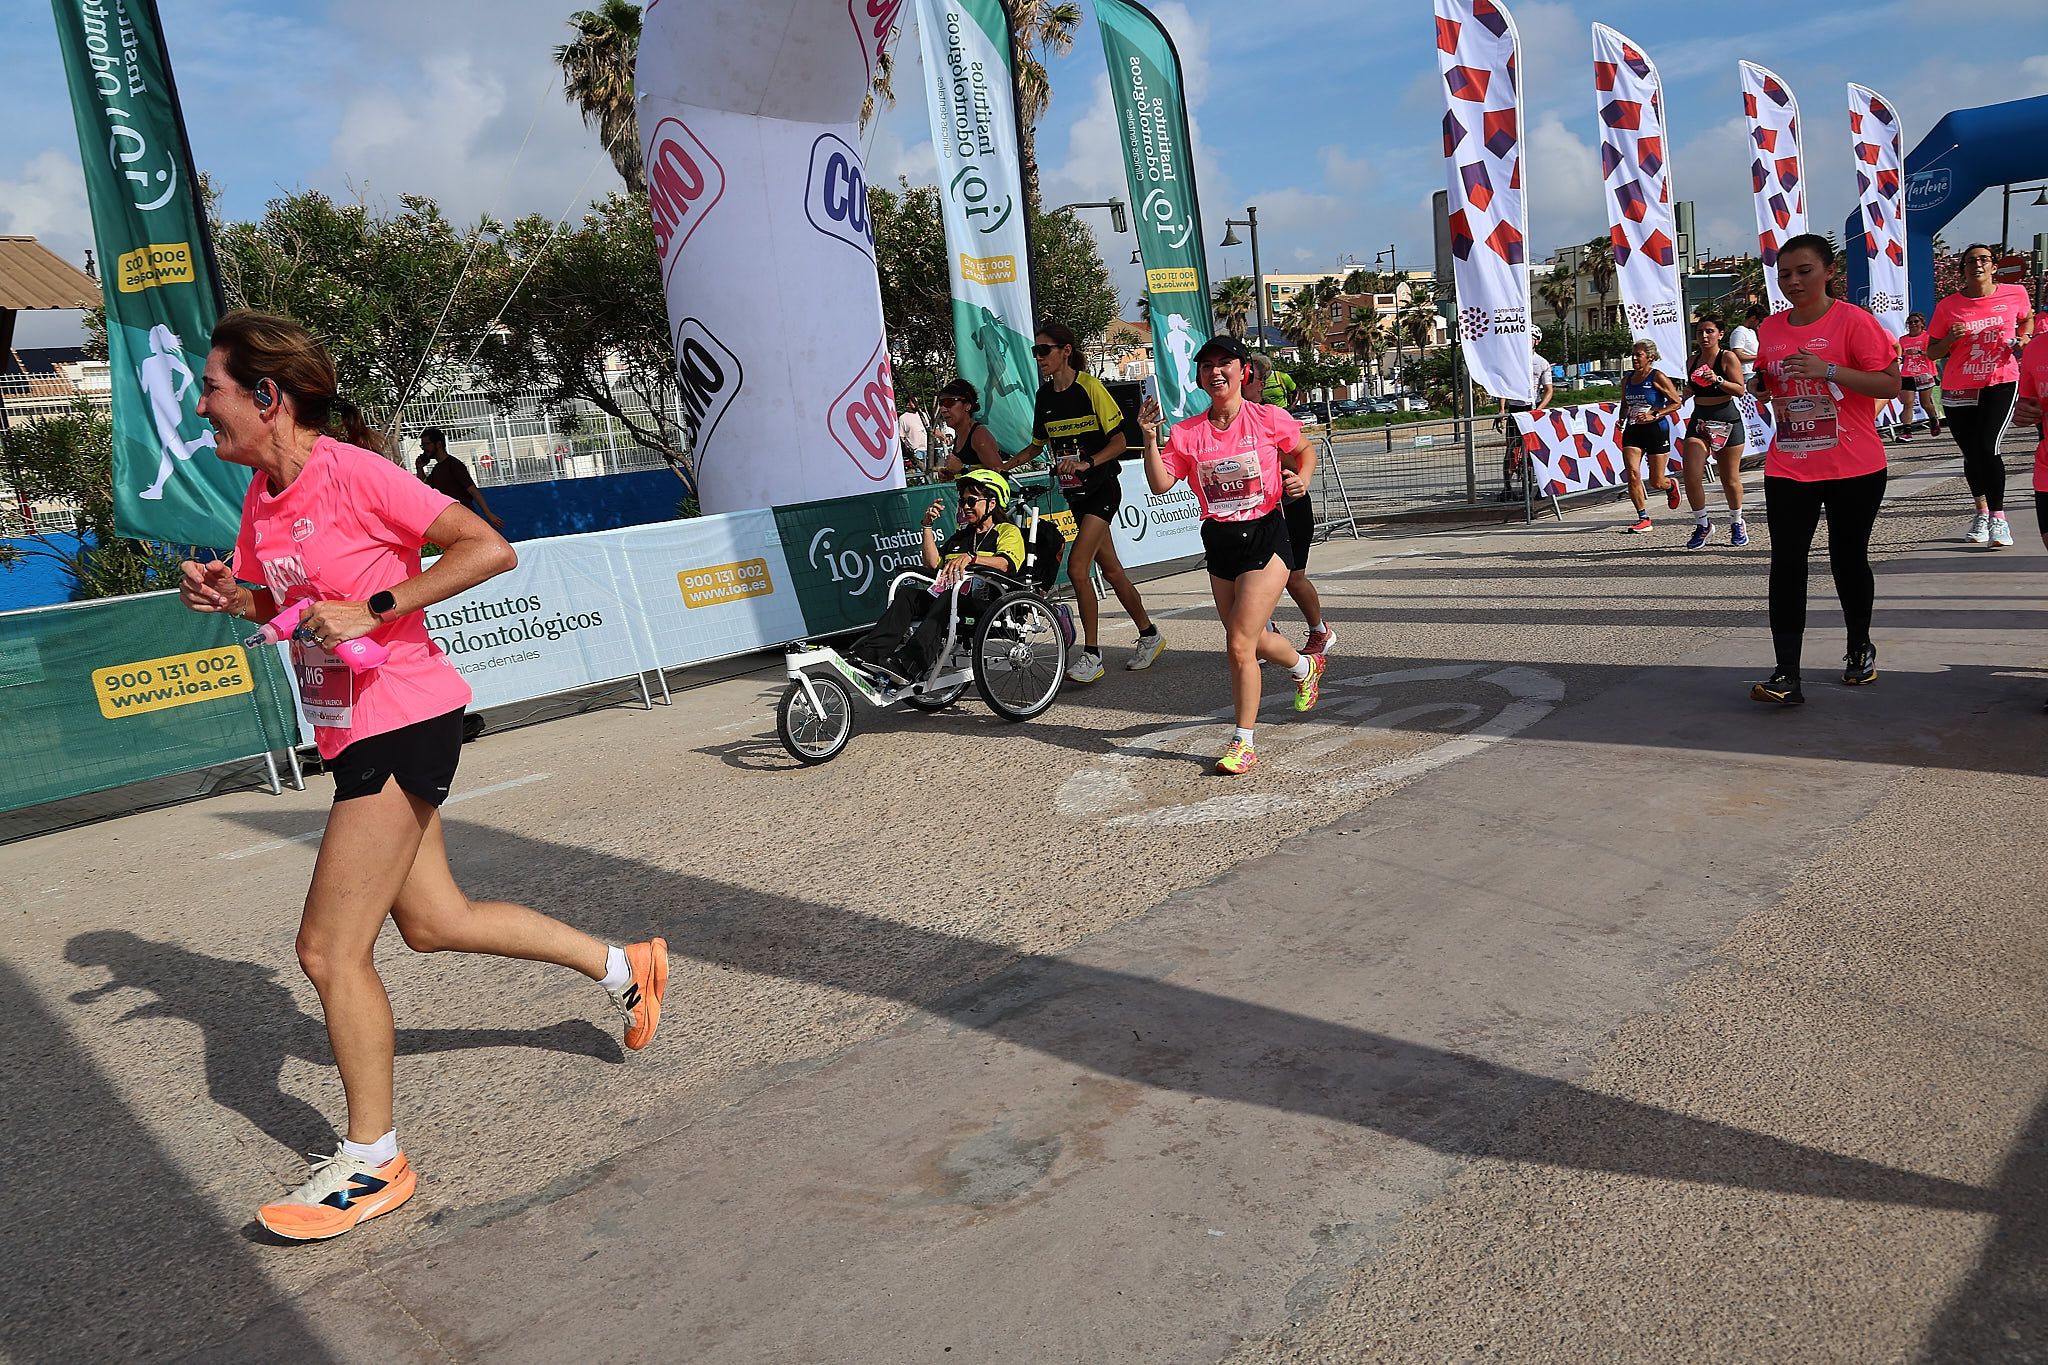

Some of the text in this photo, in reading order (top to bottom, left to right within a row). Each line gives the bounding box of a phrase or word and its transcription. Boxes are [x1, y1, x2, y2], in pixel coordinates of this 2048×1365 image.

[1964, 316, 2005, 331] ARRERA
[1962, 363, 1998, 375] MUJER
[1791, 420, 1816, 432] 016
[1221, 480, 1244, 492] 016
[1144, 489, 1196, 507] Institutos
[871, 528, 945, 552] Instituos
[684, 564, 764, 589] 900 131 002
[689, 579, 767, 602] www.ioa.es
[424, 594, 541, 631] Institutos
[431, 610, 603, 656] Odontológicos
[487, 649, 541, 669] dentales
[105, 654, 239, 692] 900 131 002
[305, 666, 324, 686] 016
[110, 673, 243, 708] www.ioa.es
